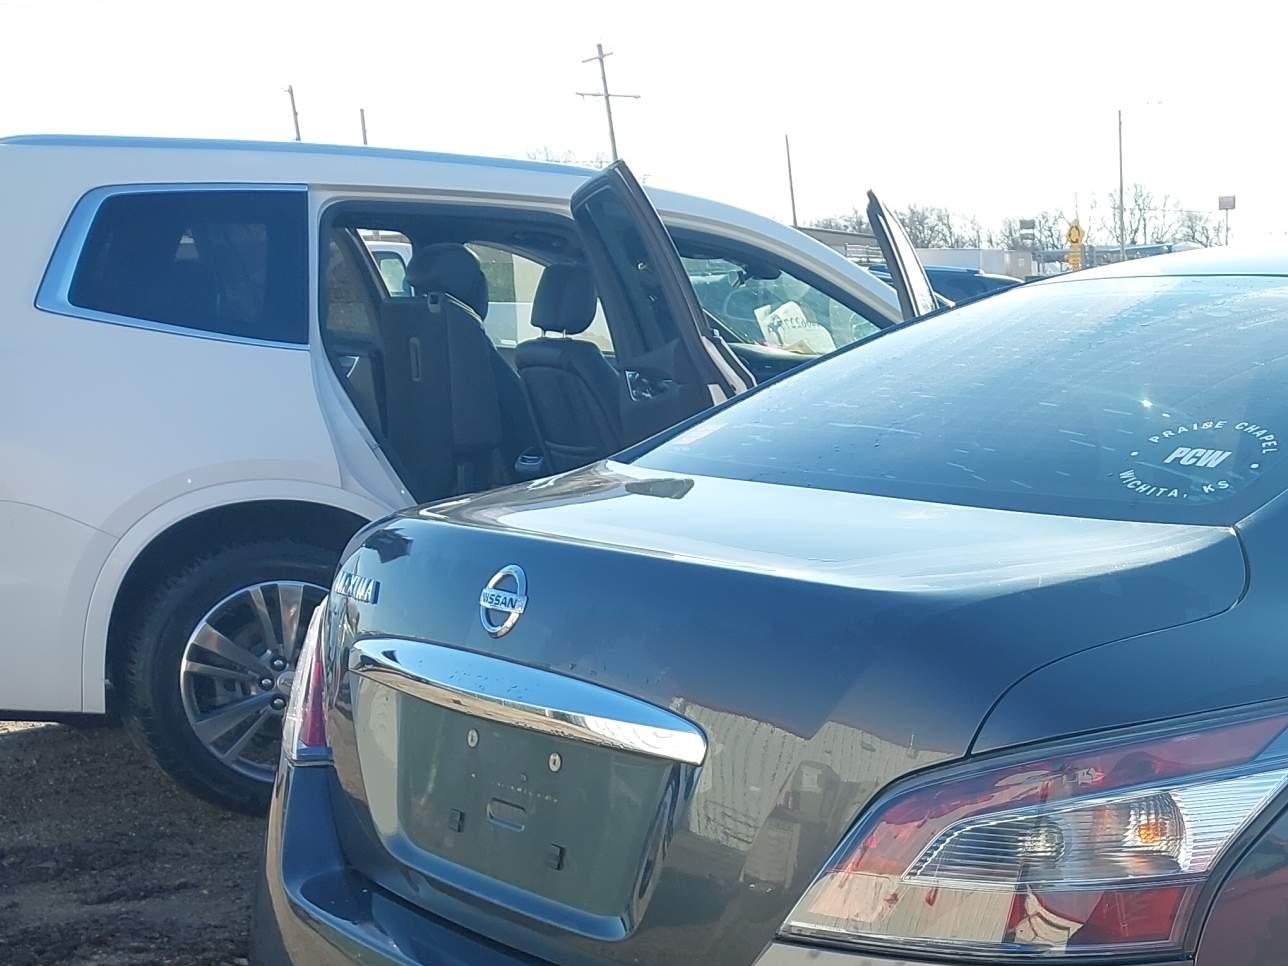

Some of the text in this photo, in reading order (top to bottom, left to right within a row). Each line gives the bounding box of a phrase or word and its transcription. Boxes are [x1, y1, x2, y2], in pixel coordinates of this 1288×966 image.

[1148, 420, 1278, 454] PRAISE CHAPEL
[1163, 447, 1232, 468] PCW
[1119, 469, 1230, 498] WICHITA, KS
